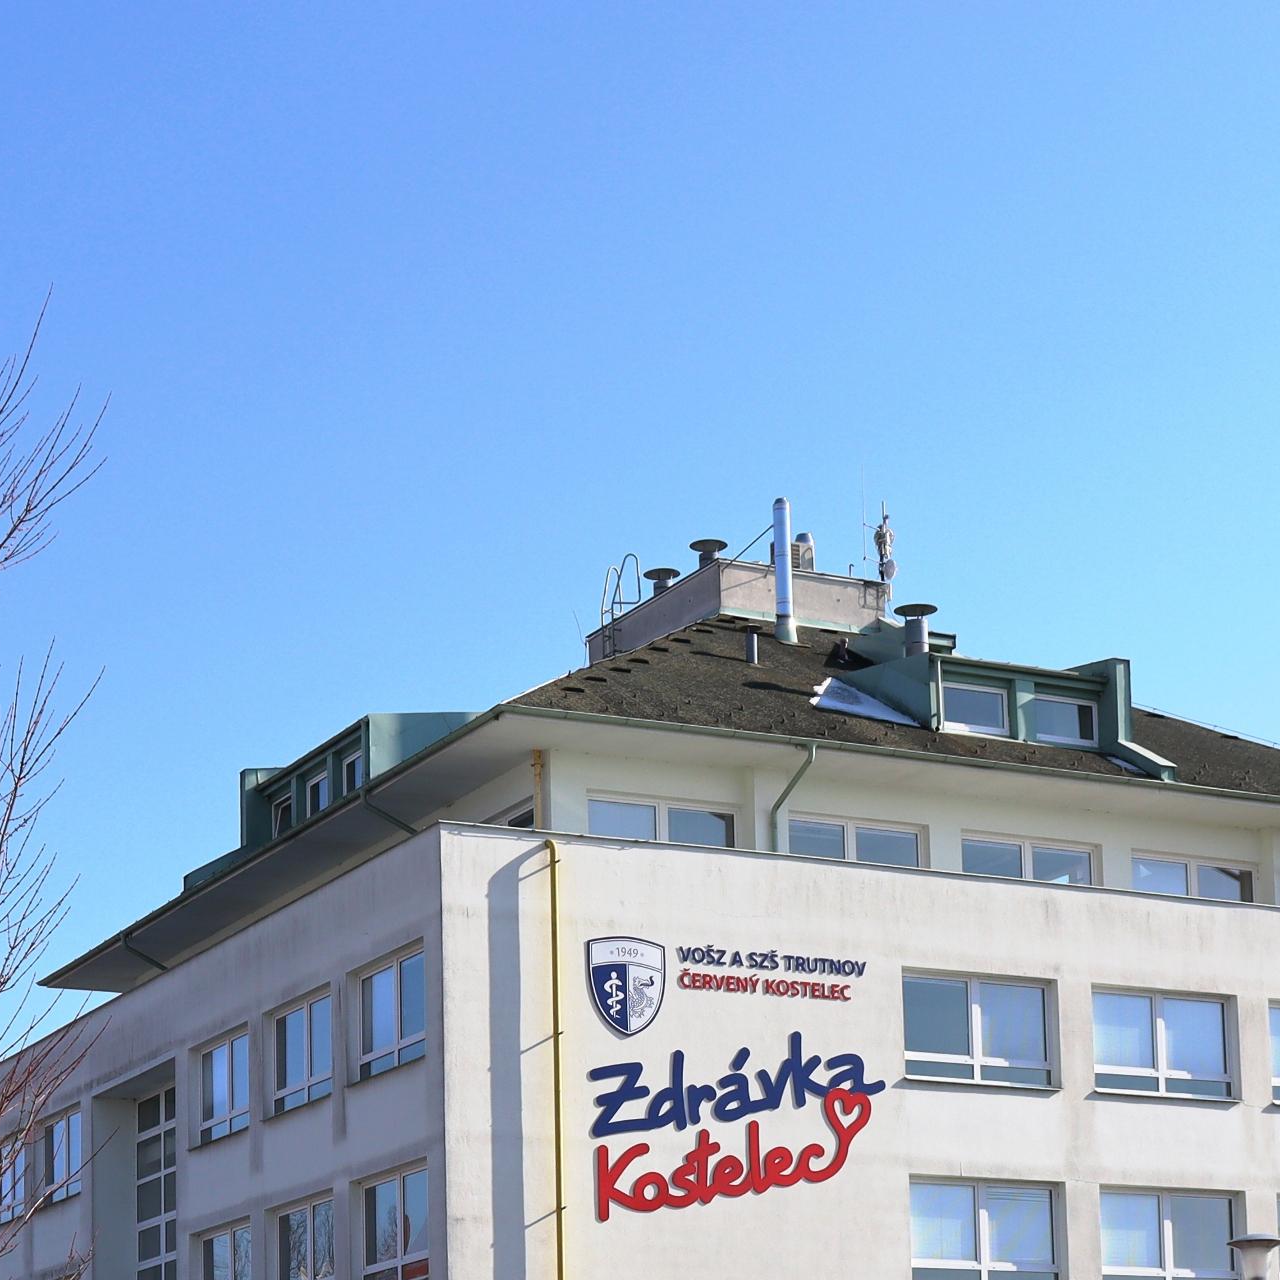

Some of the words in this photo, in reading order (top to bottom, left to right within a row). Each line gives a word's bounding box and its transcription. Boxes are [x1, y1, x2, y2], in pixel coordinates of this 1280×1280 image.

[615, 947, 639, 958] 1949
[677, 944, 727, 966] VOŠZ
[730, 950, 744, 967] A
[747, 949, 779, 970] SZŠ
[781, 954, 867, 977] TRUTNOV
[678, 967, 760, 994] ČERVENÝ
[763, 978, 851, 1001] KOSTELEC
[589, 1031, 886, 1137] Zdrávka
[595, 1119, 848, 1222] Kostelec
